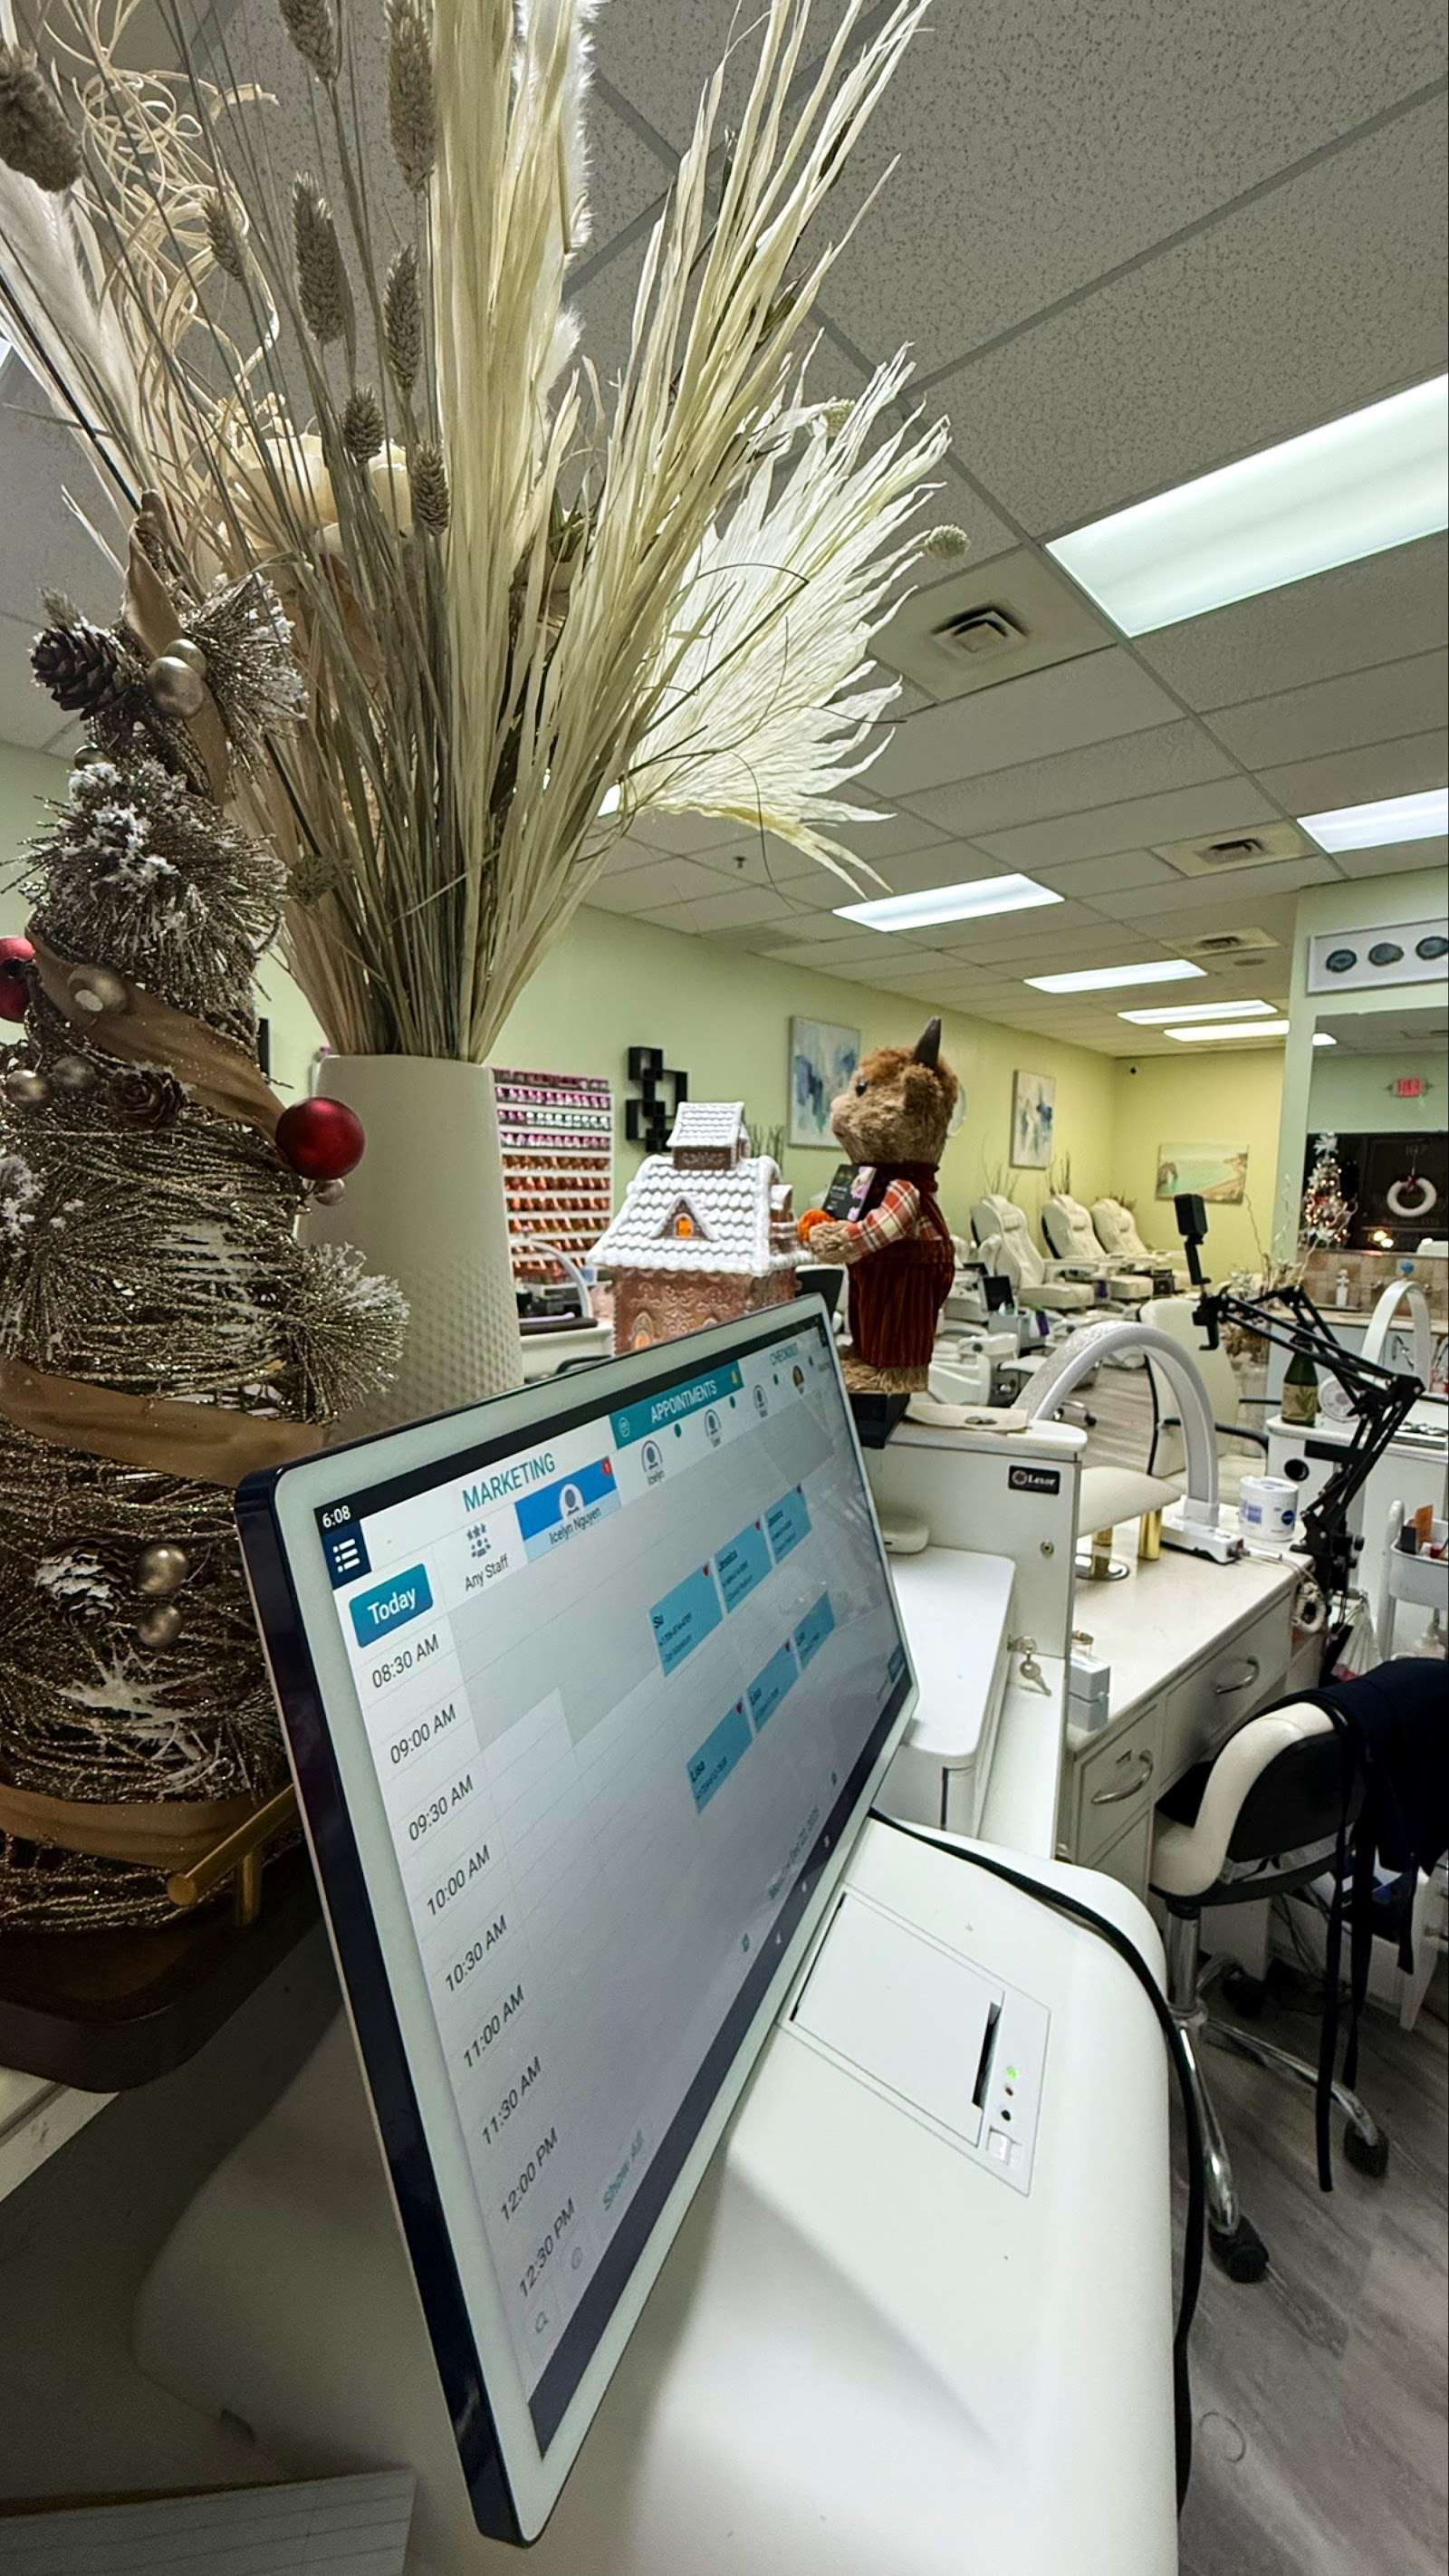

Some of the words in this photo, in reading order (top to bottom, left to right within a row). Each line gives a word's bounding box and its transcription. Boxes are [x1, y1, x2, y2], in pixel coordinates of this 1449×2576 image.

[651, 1379, 717, 1424] APPOINTMENTS
[462, 1452, 555, 1513] MARKETING
[322, 1504, 351, 1528] 6:08
[549, 1523, 574, 1544] Icelyn
[572, 1507, 601, 1531] Nguyen
[465, 1572, 484, 1591] Any
[485, 1552, 509, 1579] Staff
[367, 1588, 416, 1624] Today
[372, 1650, 413, 1688] 08:30
[417, 1633, 439, 1662] AM
[390, 1723, 430, 1764] 09:00
[434, 1704, 456, 1734] AM
[408, 1796, 448, 1841] 09:30
[451, 1774, 474, 1806] AM
[427, 1869, 465, 1916] 10:00
[469, 1844, 490, 1879] AM
[446, 1942, 483, 1992] 10:30
[486, 1914, 507, 1951] AM
[464, 2014, 501, 2068] 11:00
[504, 1985, 524, 2023] AM
[483, 2089, 518, 2145] 11:30
[521, 2056, 541, 2096] AM
[501, 2161, 536, 2220] 12:00
[535, 2127, 558, 2167] PM
[519, 2235, 554, 2297] 12:30
[553, 2197, 574, 2239] PM
